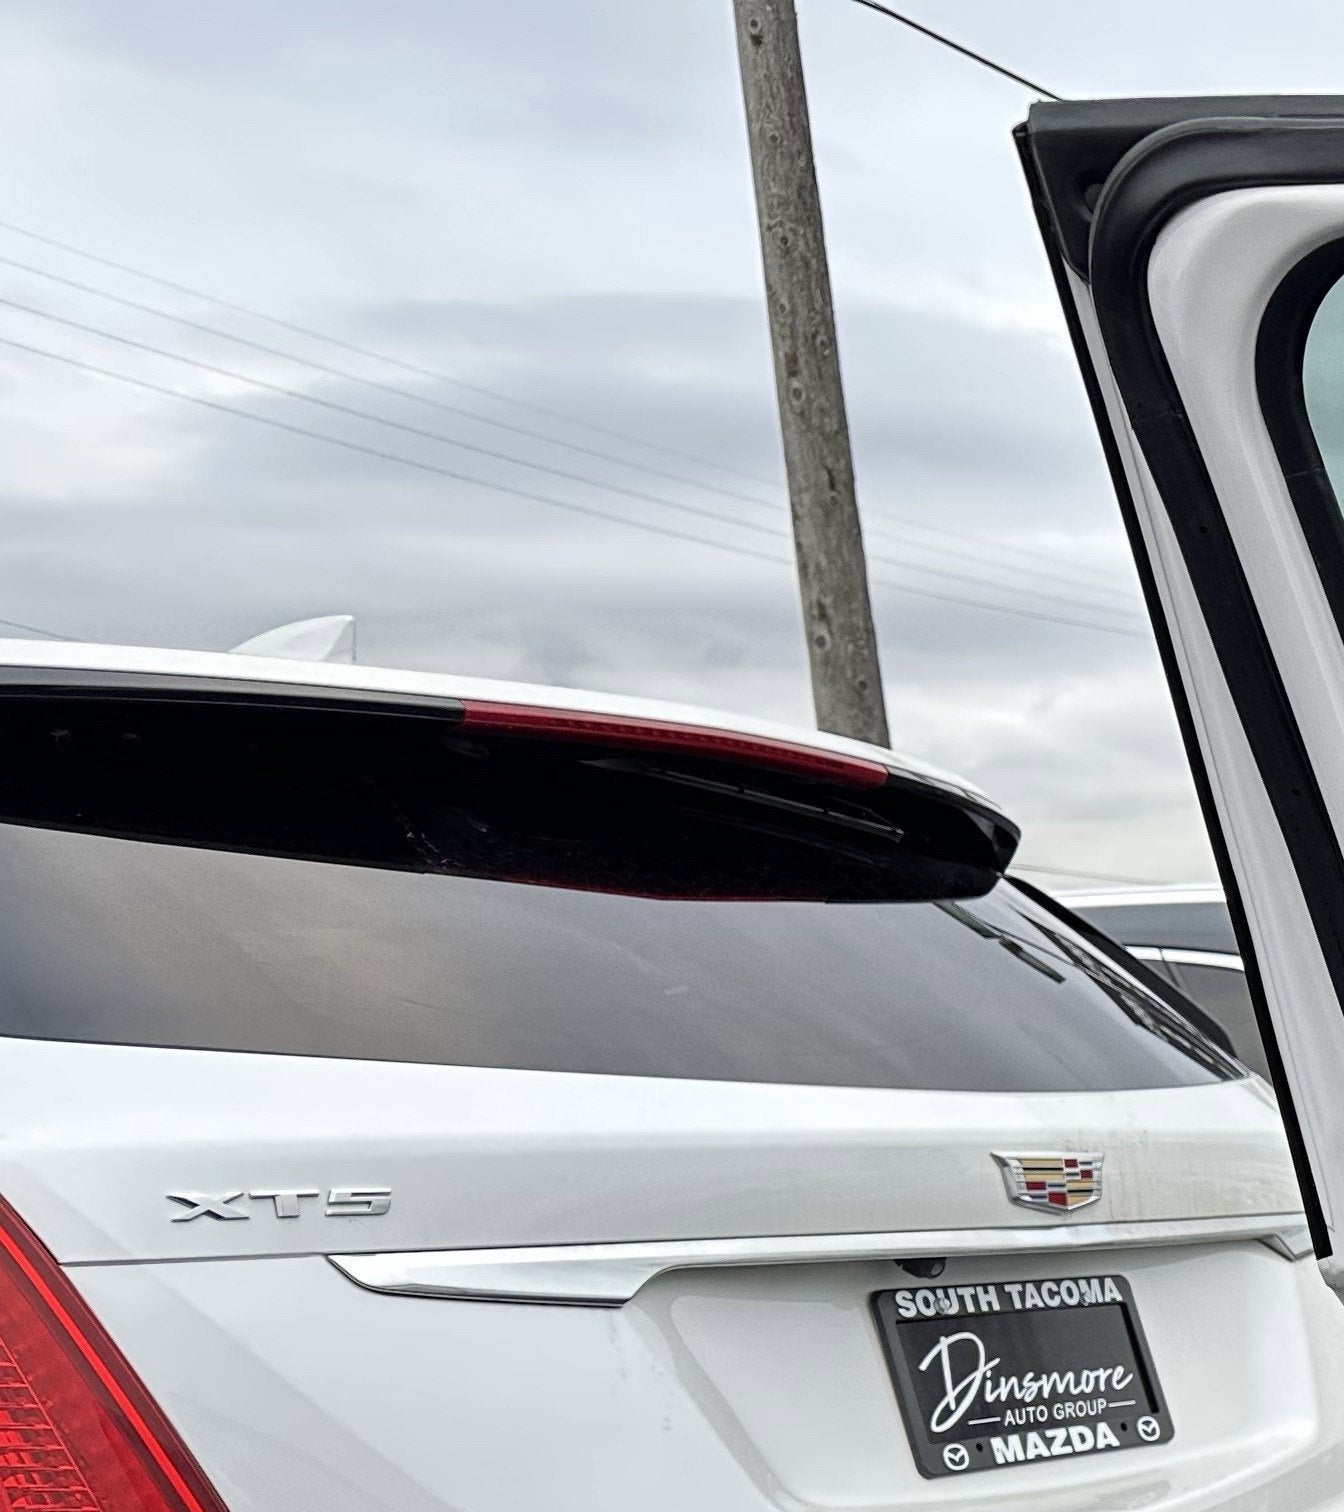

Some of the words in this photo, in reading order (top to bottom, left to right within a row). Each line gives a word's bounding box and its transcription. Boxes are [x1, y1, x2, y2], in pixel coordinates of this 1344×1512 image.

[165, 1187, 392, 1223] XT5
[895, 1285, 1000, 1318] SOUTH
[1004, 1277, 1123, 1310] TACOMA
[918, 1331, 1133, 1433] Dinsmore
[1004, 1403, 1048, 1427] AUTO
[1053, 1398, 1107, 1422] GROUP
[990, 1422, 1120, 1464] MAZDA
